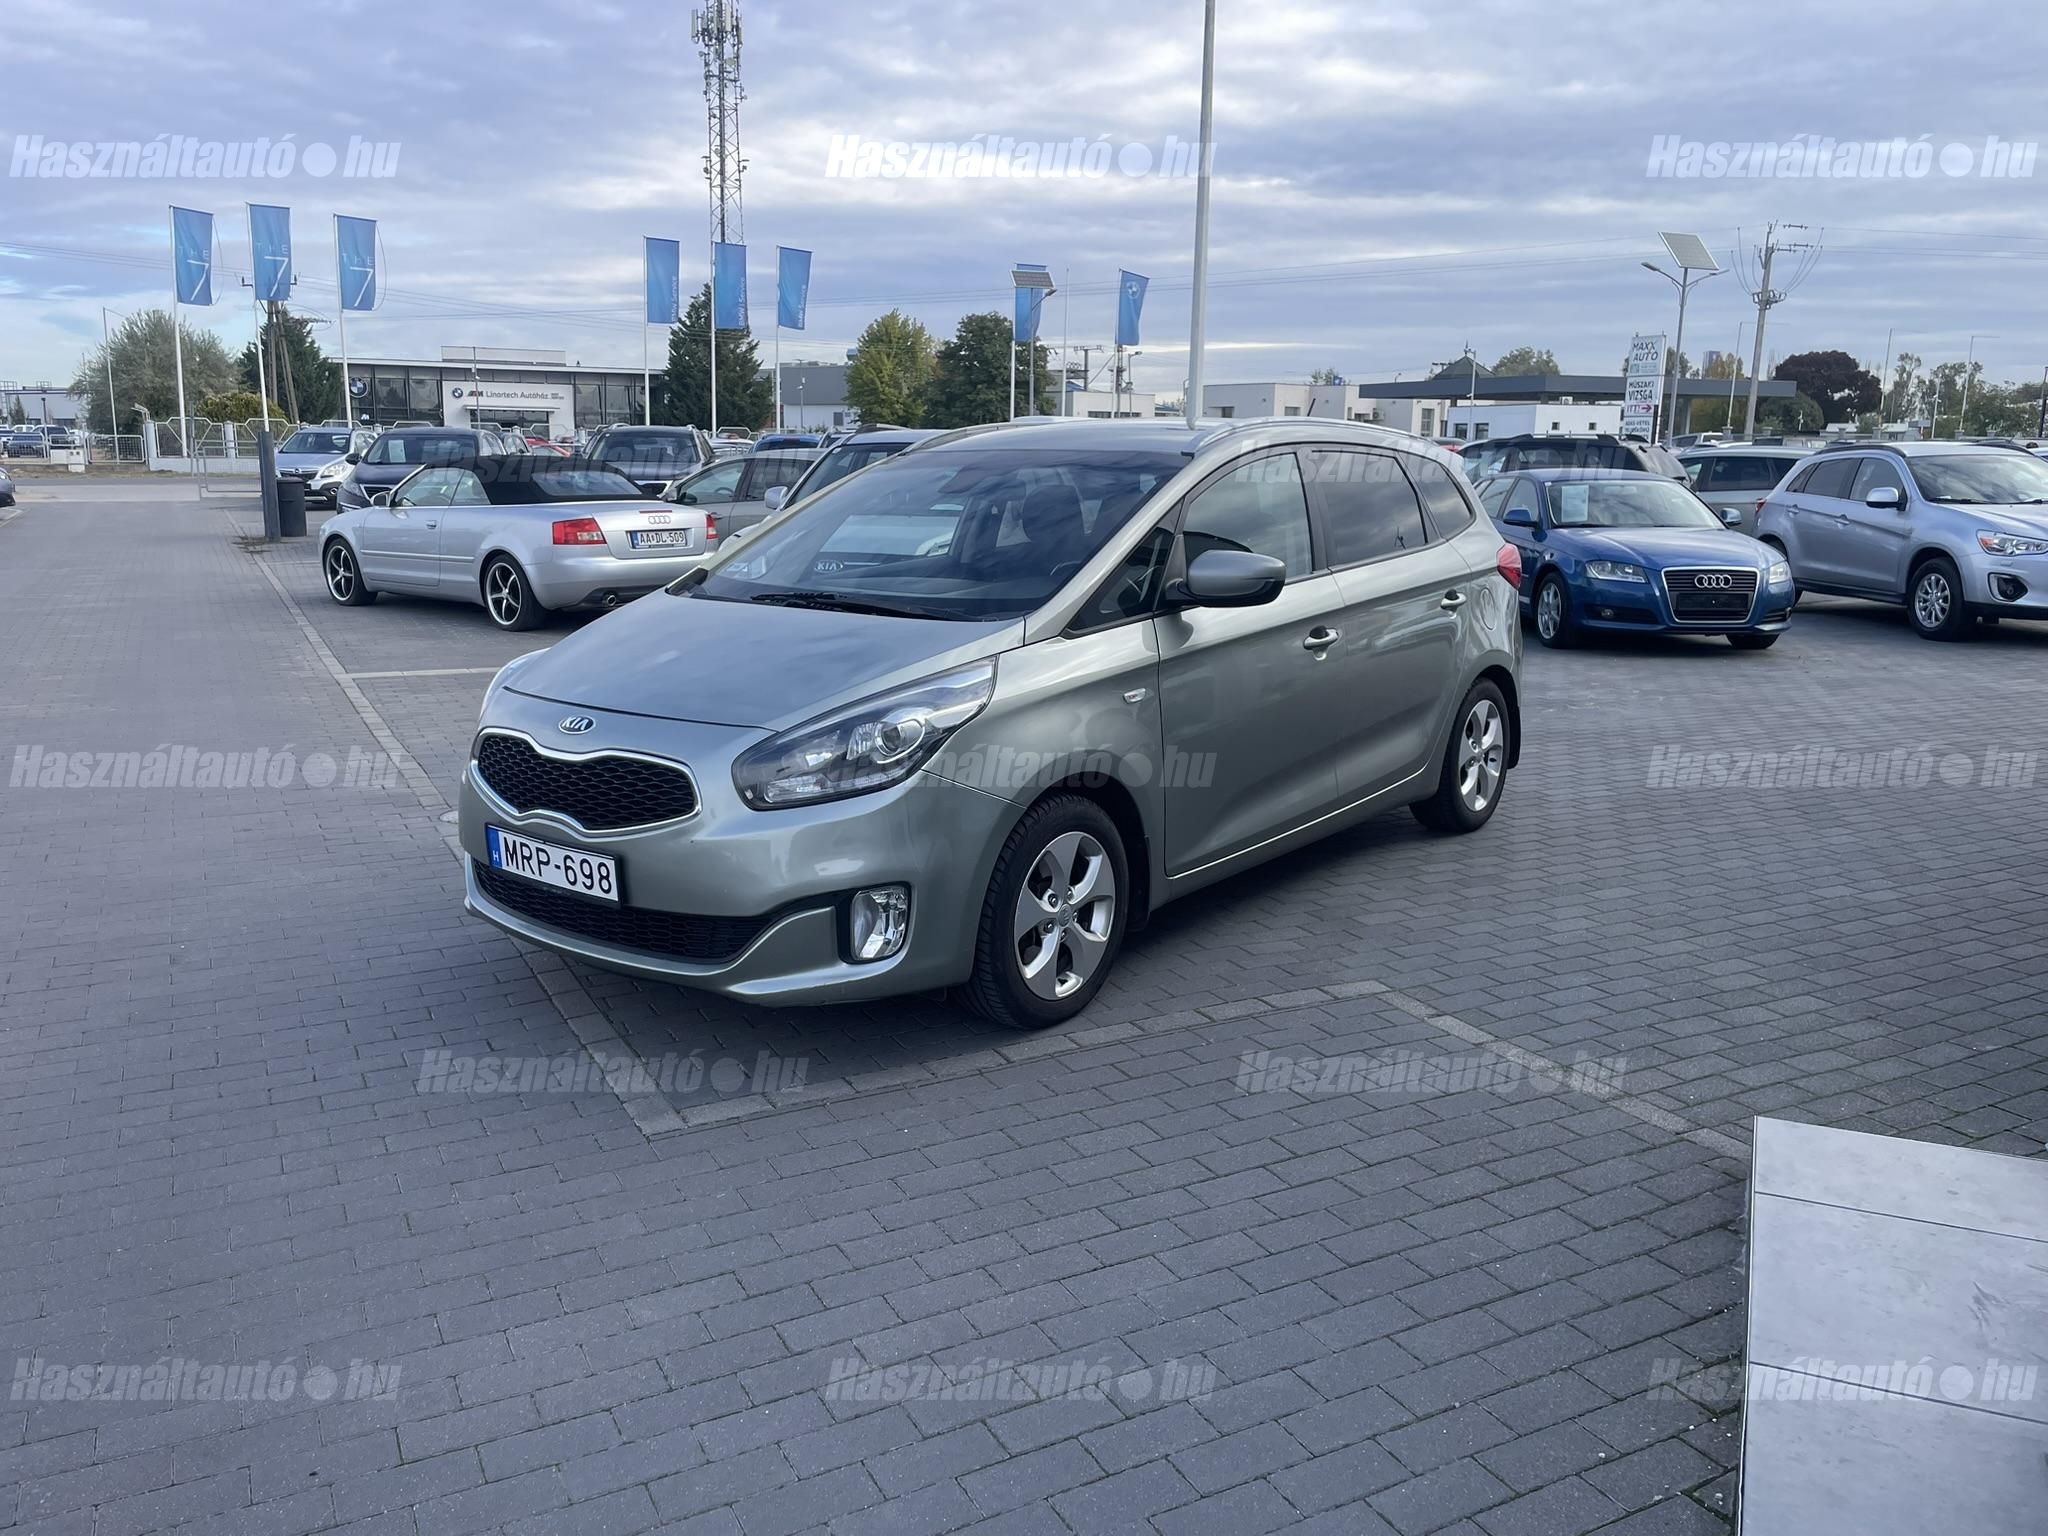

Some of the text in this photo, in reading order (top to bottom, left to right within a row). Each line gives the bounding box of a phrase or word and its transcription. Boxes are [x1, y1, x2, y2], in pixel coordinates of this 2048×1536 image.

[186, 259, 210, 301] 7
[264, 256, 289, 298] 7
[349, 265, 374, 307] 7
[1633, 351, 1659, 361] AUTO
[1628, 389, 1653, 401] VIZSGA
[817, 562, 837, 570] KIA
[561, 716, 589, 731] KIA
[503, 836, 612, 894] MRP-698
